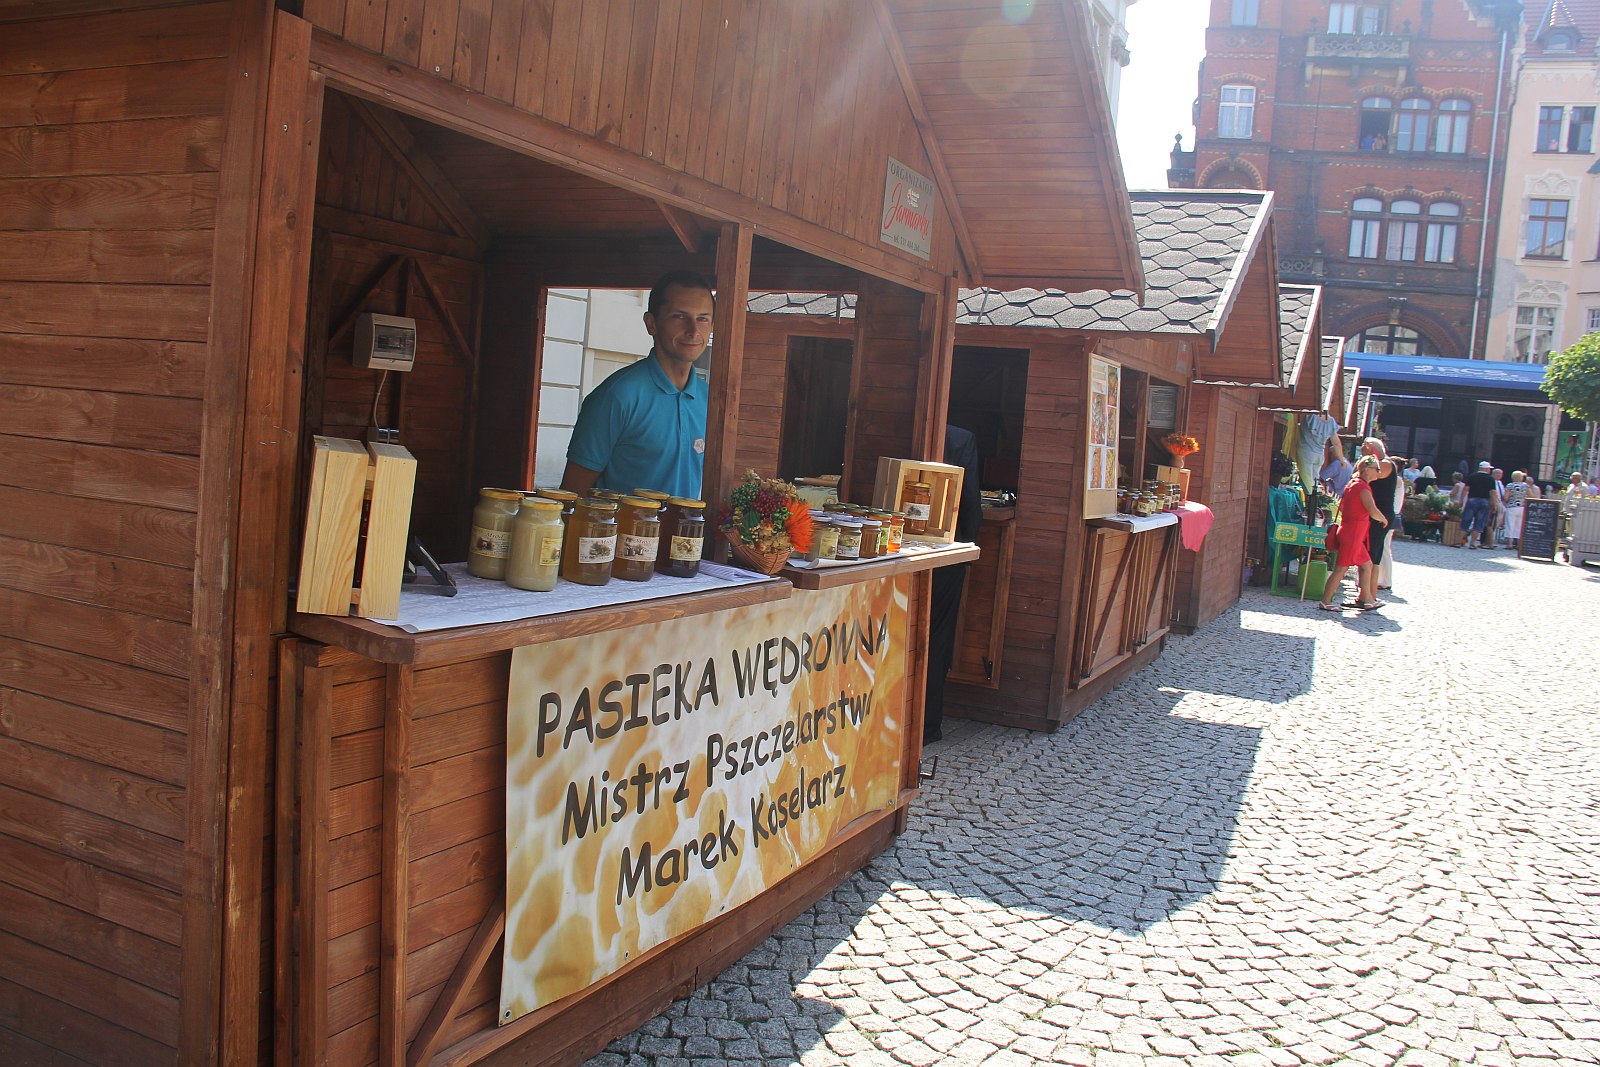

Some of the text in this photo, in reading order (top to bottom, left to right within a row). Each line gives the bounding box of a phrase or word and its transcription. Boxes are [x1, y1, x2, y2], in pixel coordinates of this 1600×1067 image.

[890, 161, 933, 196] ORGANIZATOR
[1304, 536, 1326, 545] LEGN
[536, 657, 719, 758] PASIEKA
[562, 759, 691, 845] Mistrz
[616, 765, 847, 907] Marek Koselarz
